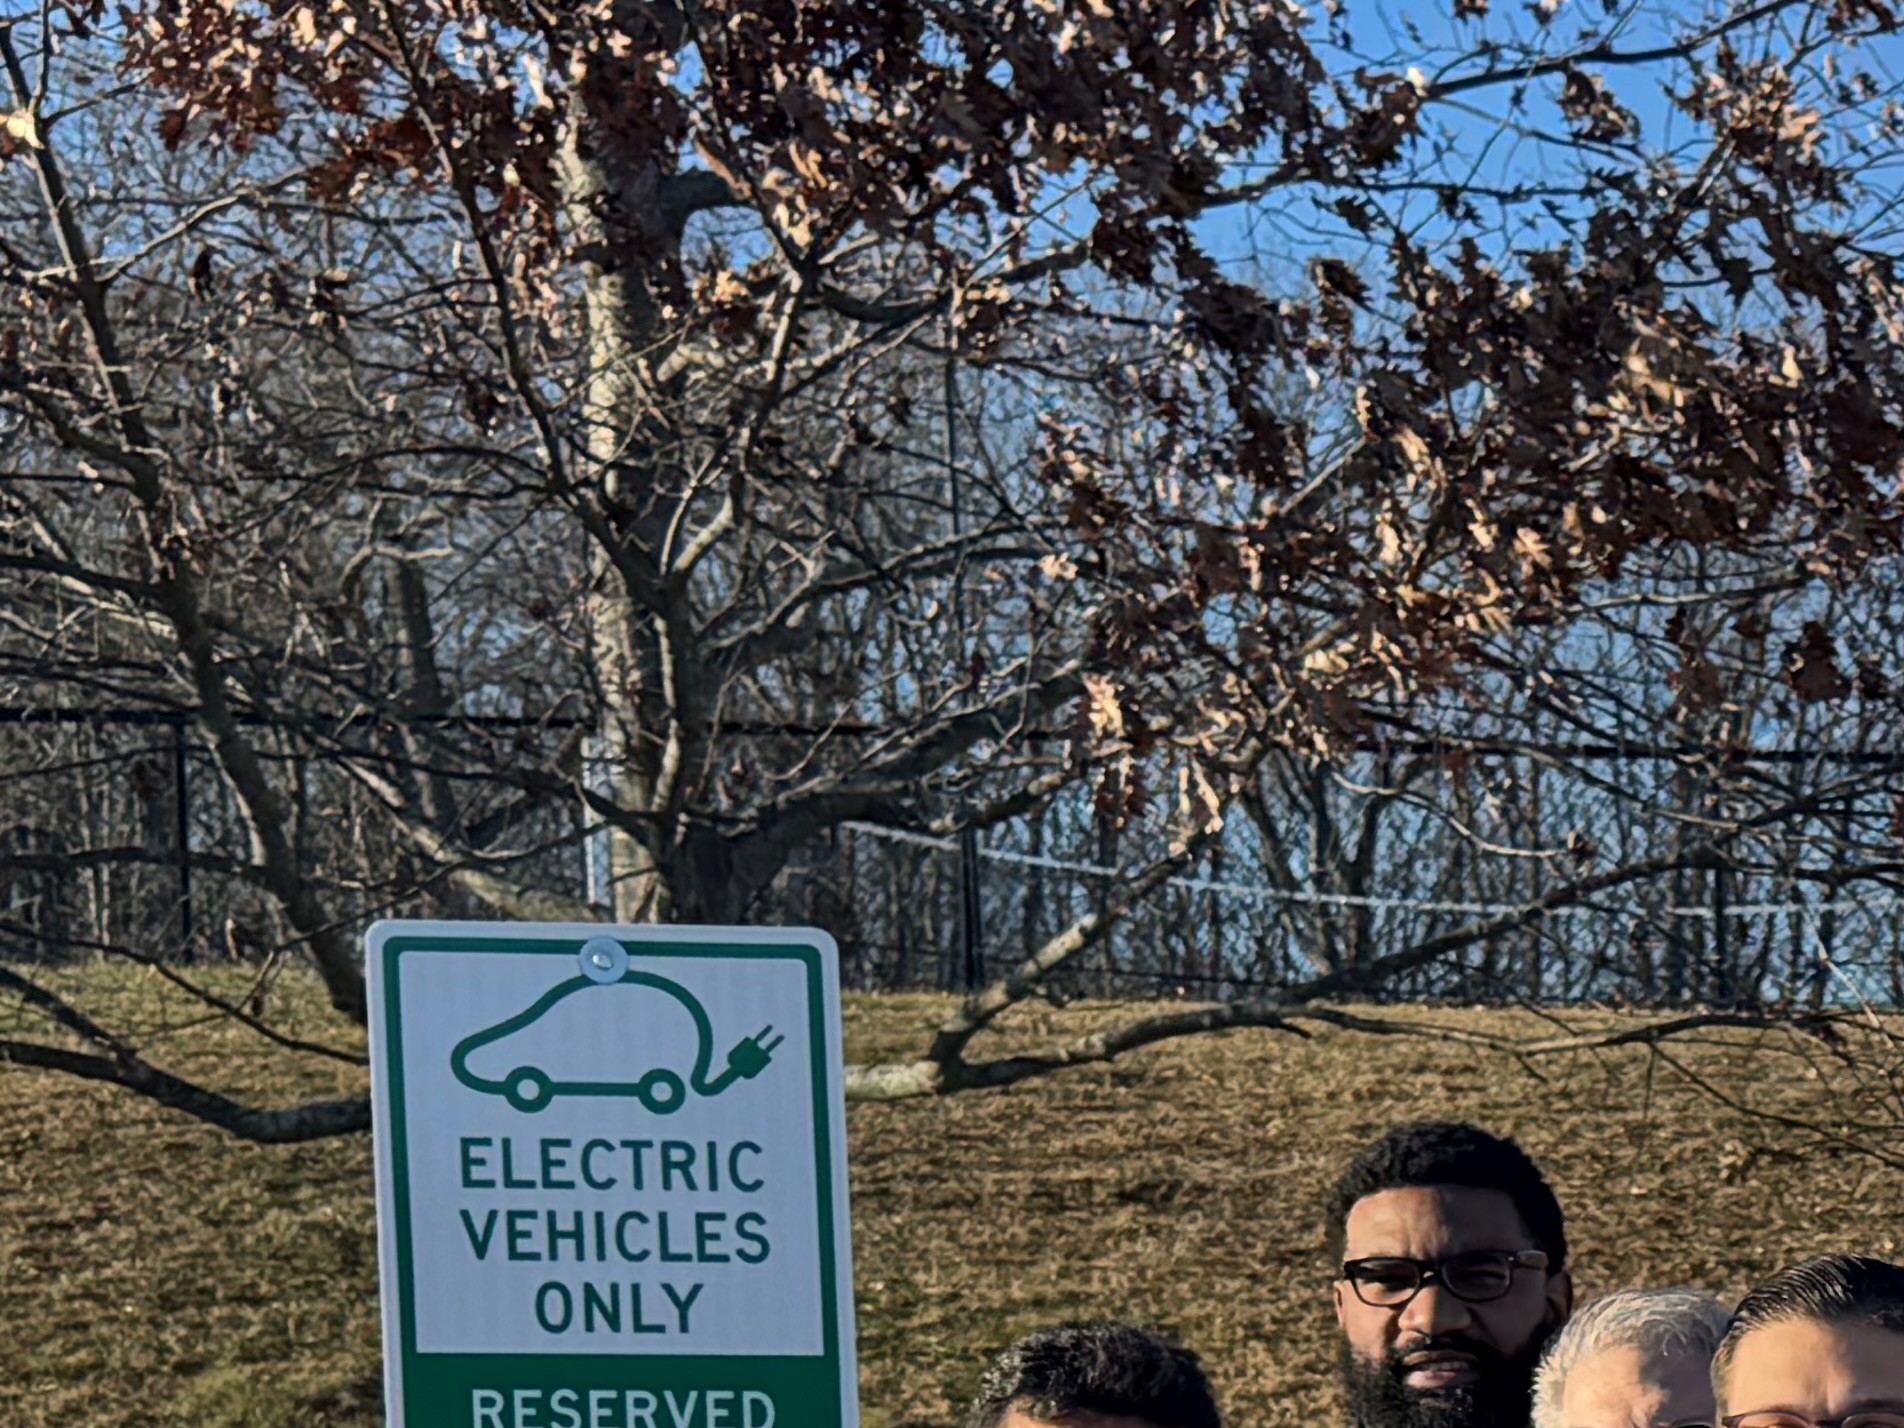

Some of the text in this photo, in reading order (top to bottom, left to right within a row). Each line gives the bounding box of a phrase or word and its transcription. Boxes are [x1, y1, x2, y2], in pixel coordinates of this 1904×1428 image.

[460, 1137, 765, 1192] ELECTRIC
[460, 1208, 771, 1263] VEHICLES
[536, 1281, 704, 1334] ONLY
